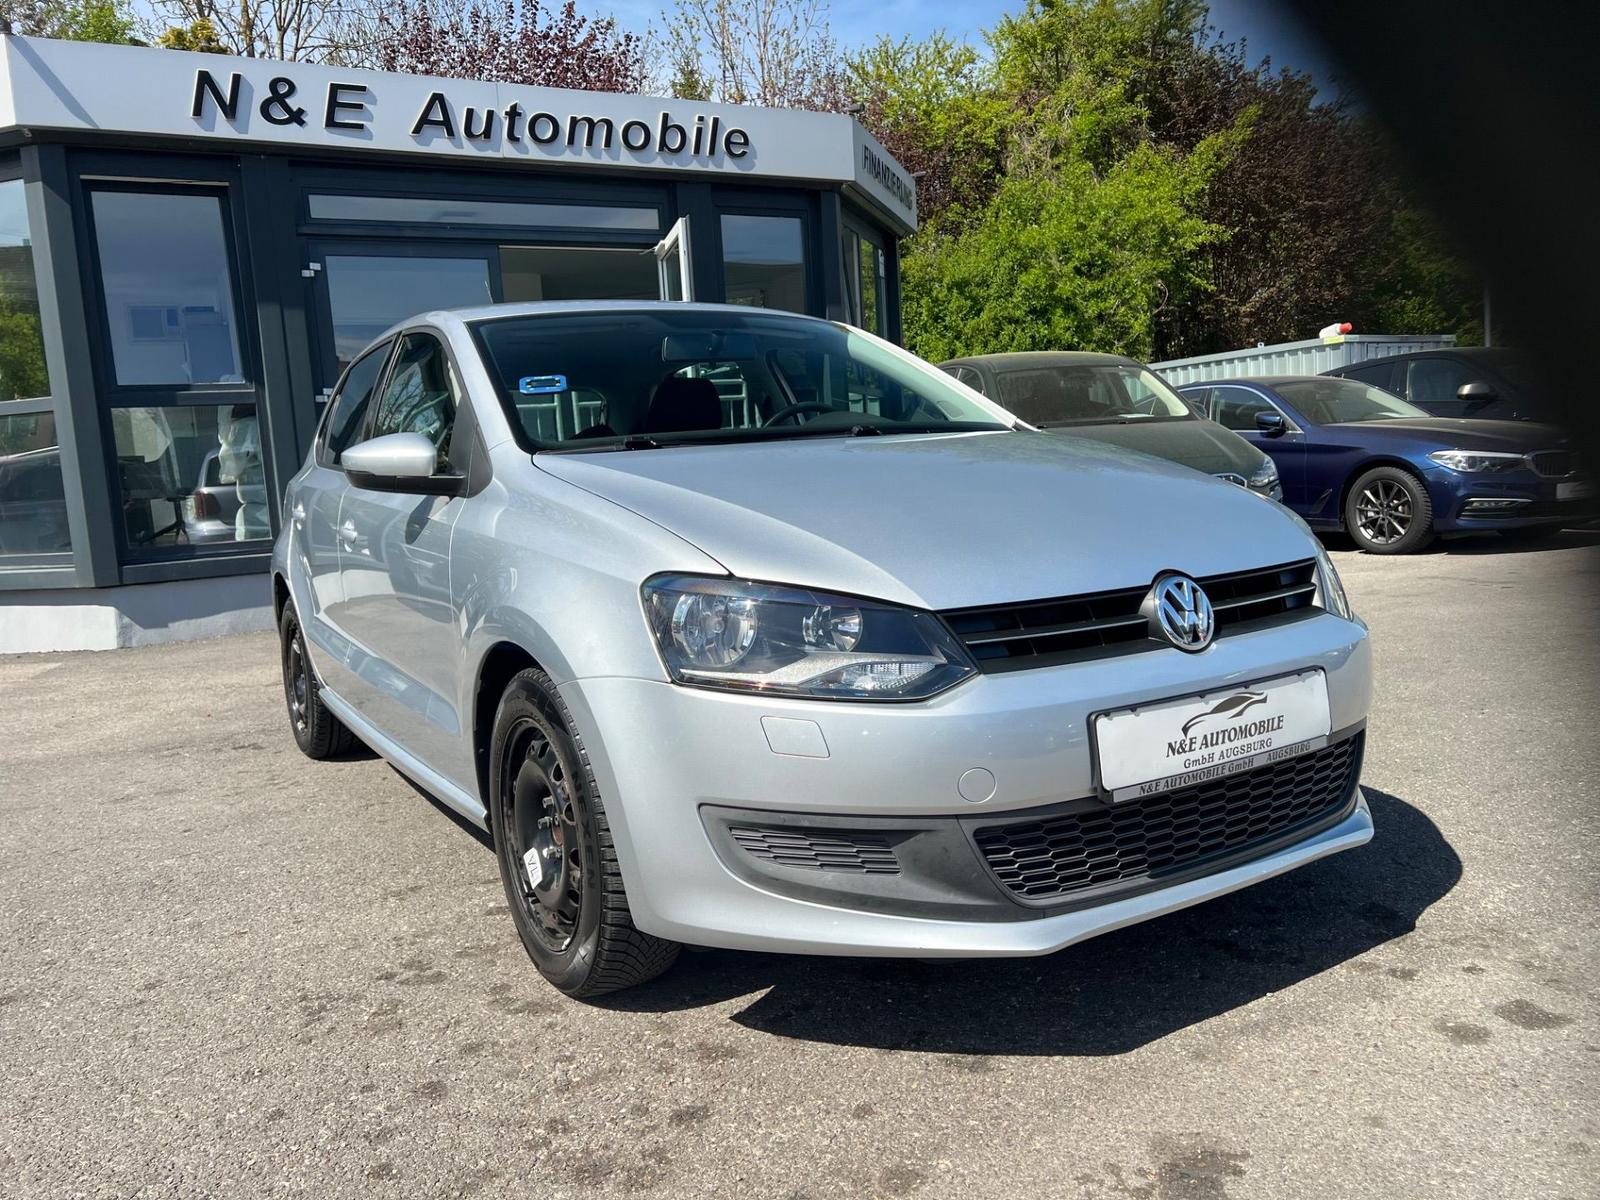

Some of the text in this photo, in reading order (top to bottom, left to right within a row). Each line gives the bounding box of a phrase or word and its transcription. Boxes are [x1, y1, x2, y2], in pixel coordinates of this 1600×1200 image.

[411, 92, 750, 158] Automobile
[1166, 715, 1284, 758] N&E AUTOMOBILE
[1183, 738, 1273, 769] GmbH AUGSBURG
[1139, 741, 1311, 796] N&E AUTOMOBILE GmbH AUGSBURG
